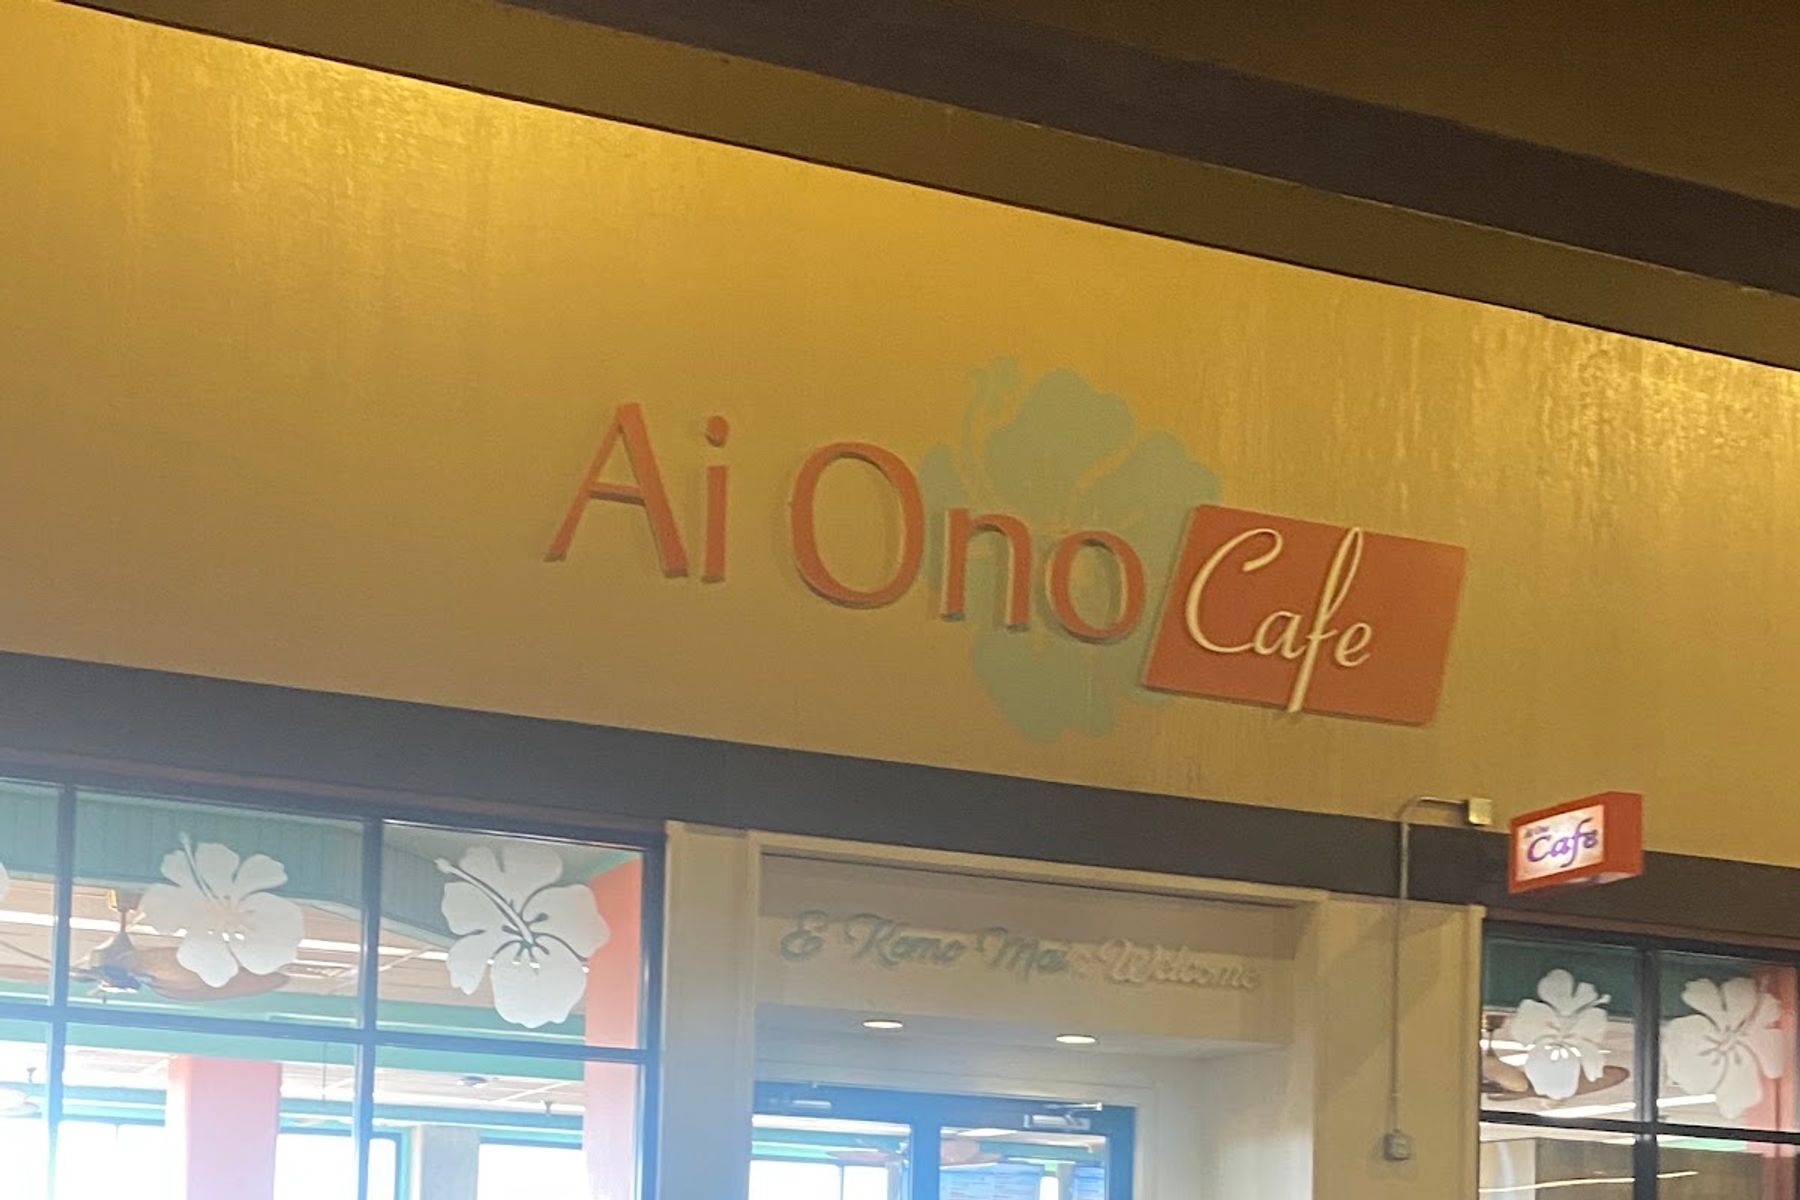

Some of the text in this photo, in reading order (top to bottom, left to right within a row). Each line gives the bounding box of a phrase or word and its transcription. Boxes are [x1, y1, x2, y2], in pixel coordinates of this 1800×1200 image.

[543, 402, 1147, 645] Ai Ono
[1185, 525, 1372, 714] Cafe
[1526, 816, 1599, 868] Cafe
